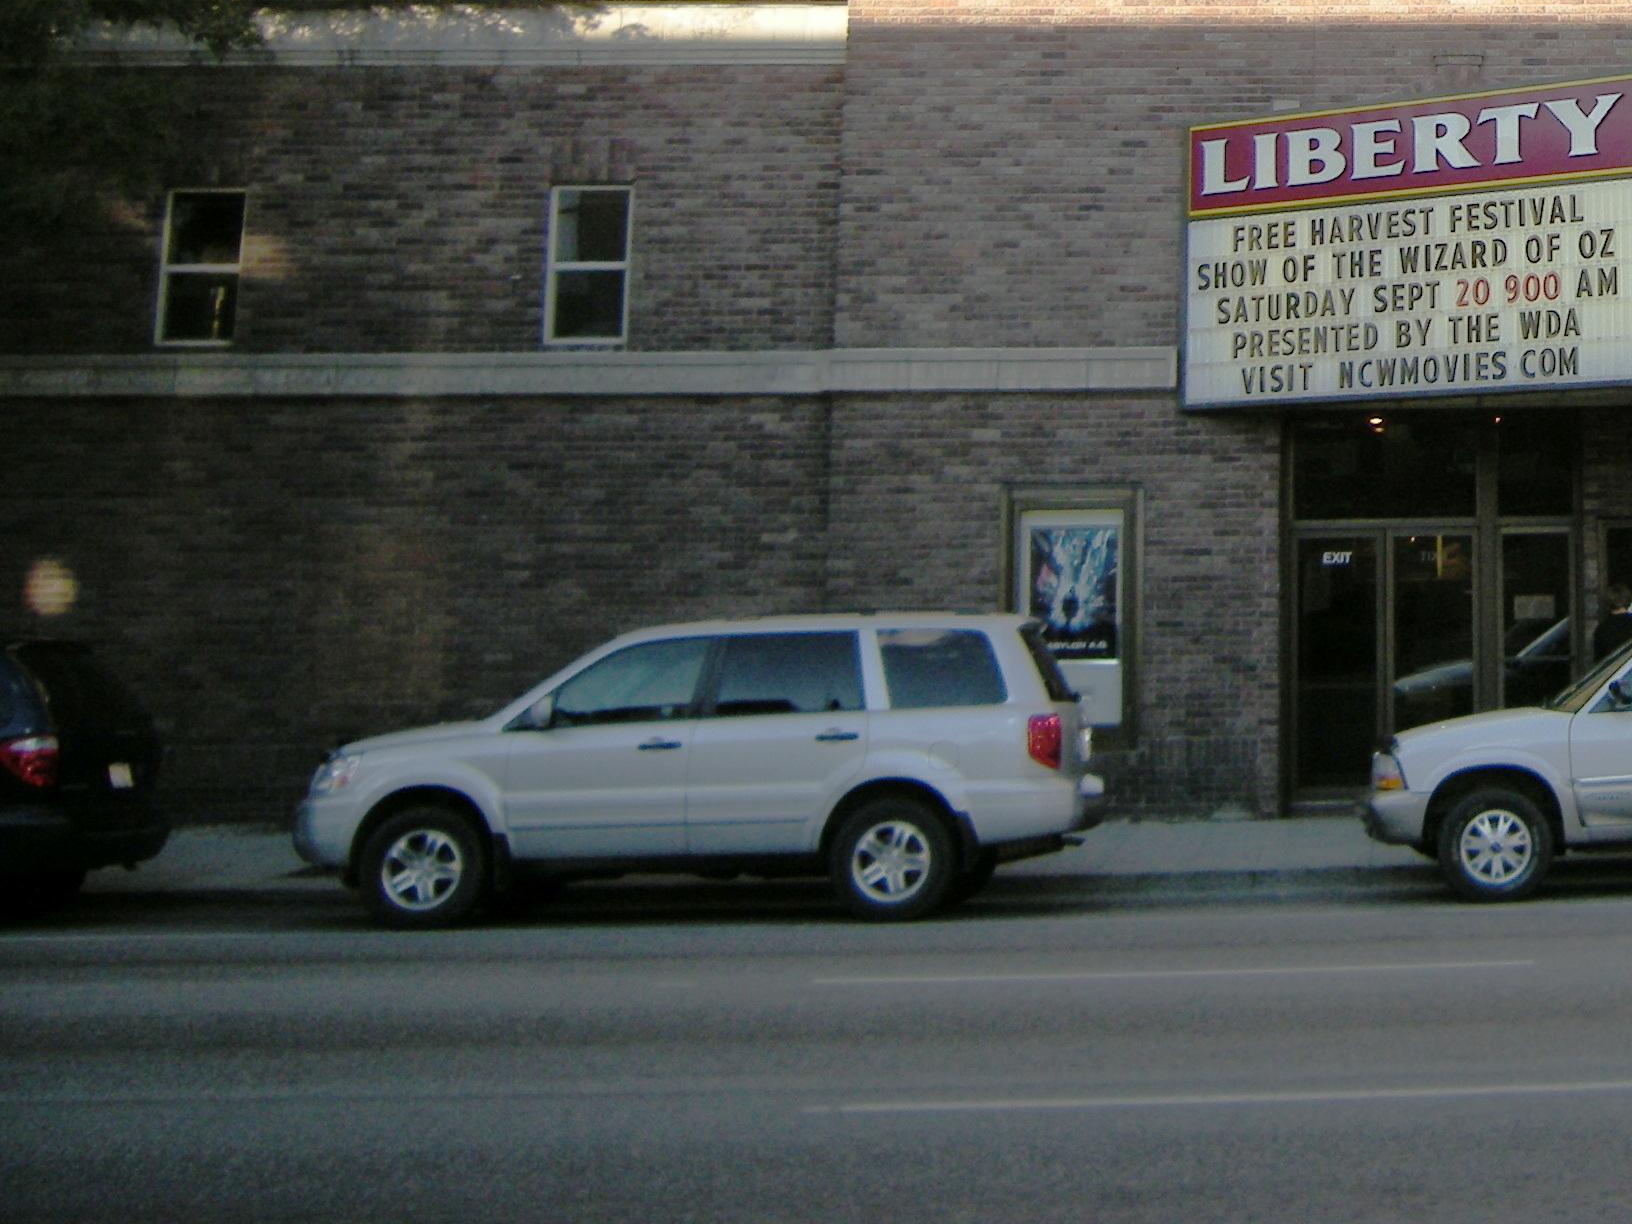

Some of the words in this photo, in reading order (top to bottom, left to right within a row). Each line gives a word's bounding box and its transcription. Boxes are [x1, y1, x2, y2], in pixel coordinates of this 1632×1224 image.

[1201, 93, 1623, 196] LIBERTY
[1233, 220, 1296, 252] FREE
[1311, 207, 1434, 246] HARVEST
[1449, 194, 1584, 232] FESTIVAL
[1197, 258, 1267, 290] SHOW
[1283, 255, 1316, 283] OF
[1333, 249, 1383, 279] THE
[1400, 240, 1507, 274] WIZARD
[1526, 235, 1560, 263] OF
[1578, 229, 1615, 259] OZ
[1217, 288, 1355, 324] SATURDAY
[1373, 281, 1440, 313] SEPT
[1456, 277, 1490, 306] 20
[1504, 272, 1562, 303] 900
[1576, 266, 1618, 299] AM
[1232, 322, 1379, 359] PRESENTED
[1396, 319, 1432, 347] BY
[1448, 314, 1500, 343] THE
[1520, 308, 1581, 340] WDA
[1241, 363, 1314, 394] VISIT
[1339, 350, 1507, 388] NCWMOVIES
[1520, 346, 1578, 376] COM
[1322, 551, 1352, 565] EXIT
